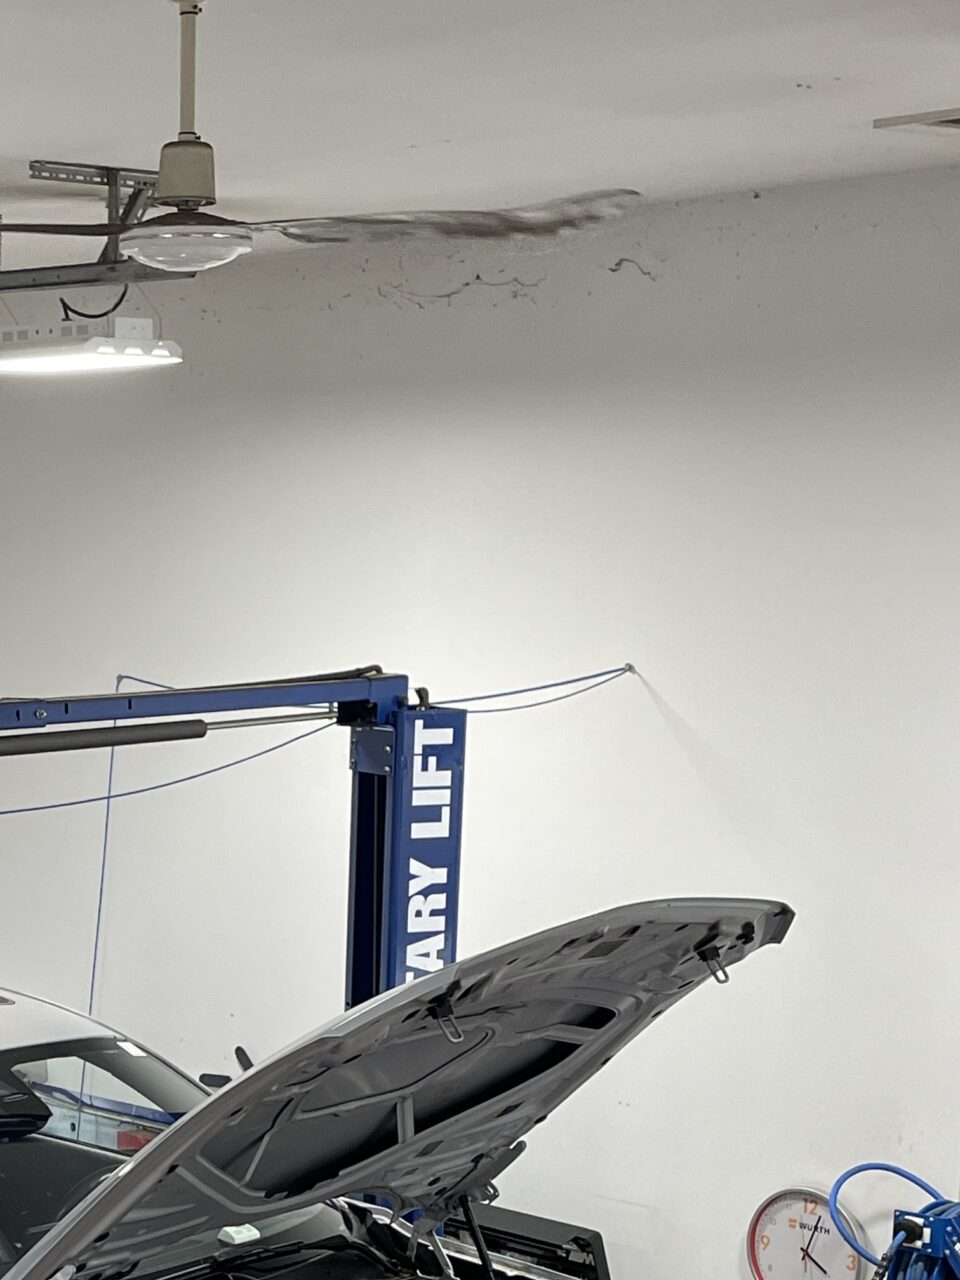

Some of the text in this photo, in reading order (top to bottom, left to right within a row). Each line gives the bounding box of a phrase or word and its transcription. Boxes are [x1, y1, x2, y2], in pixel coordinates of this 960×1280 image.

[406, 719, 454, 984] ARY LIFT
[803, 1198, 818, 1216] 12
[761, 1235, 770, 1250] 9
[846, 1254, 856, 1271] 3
